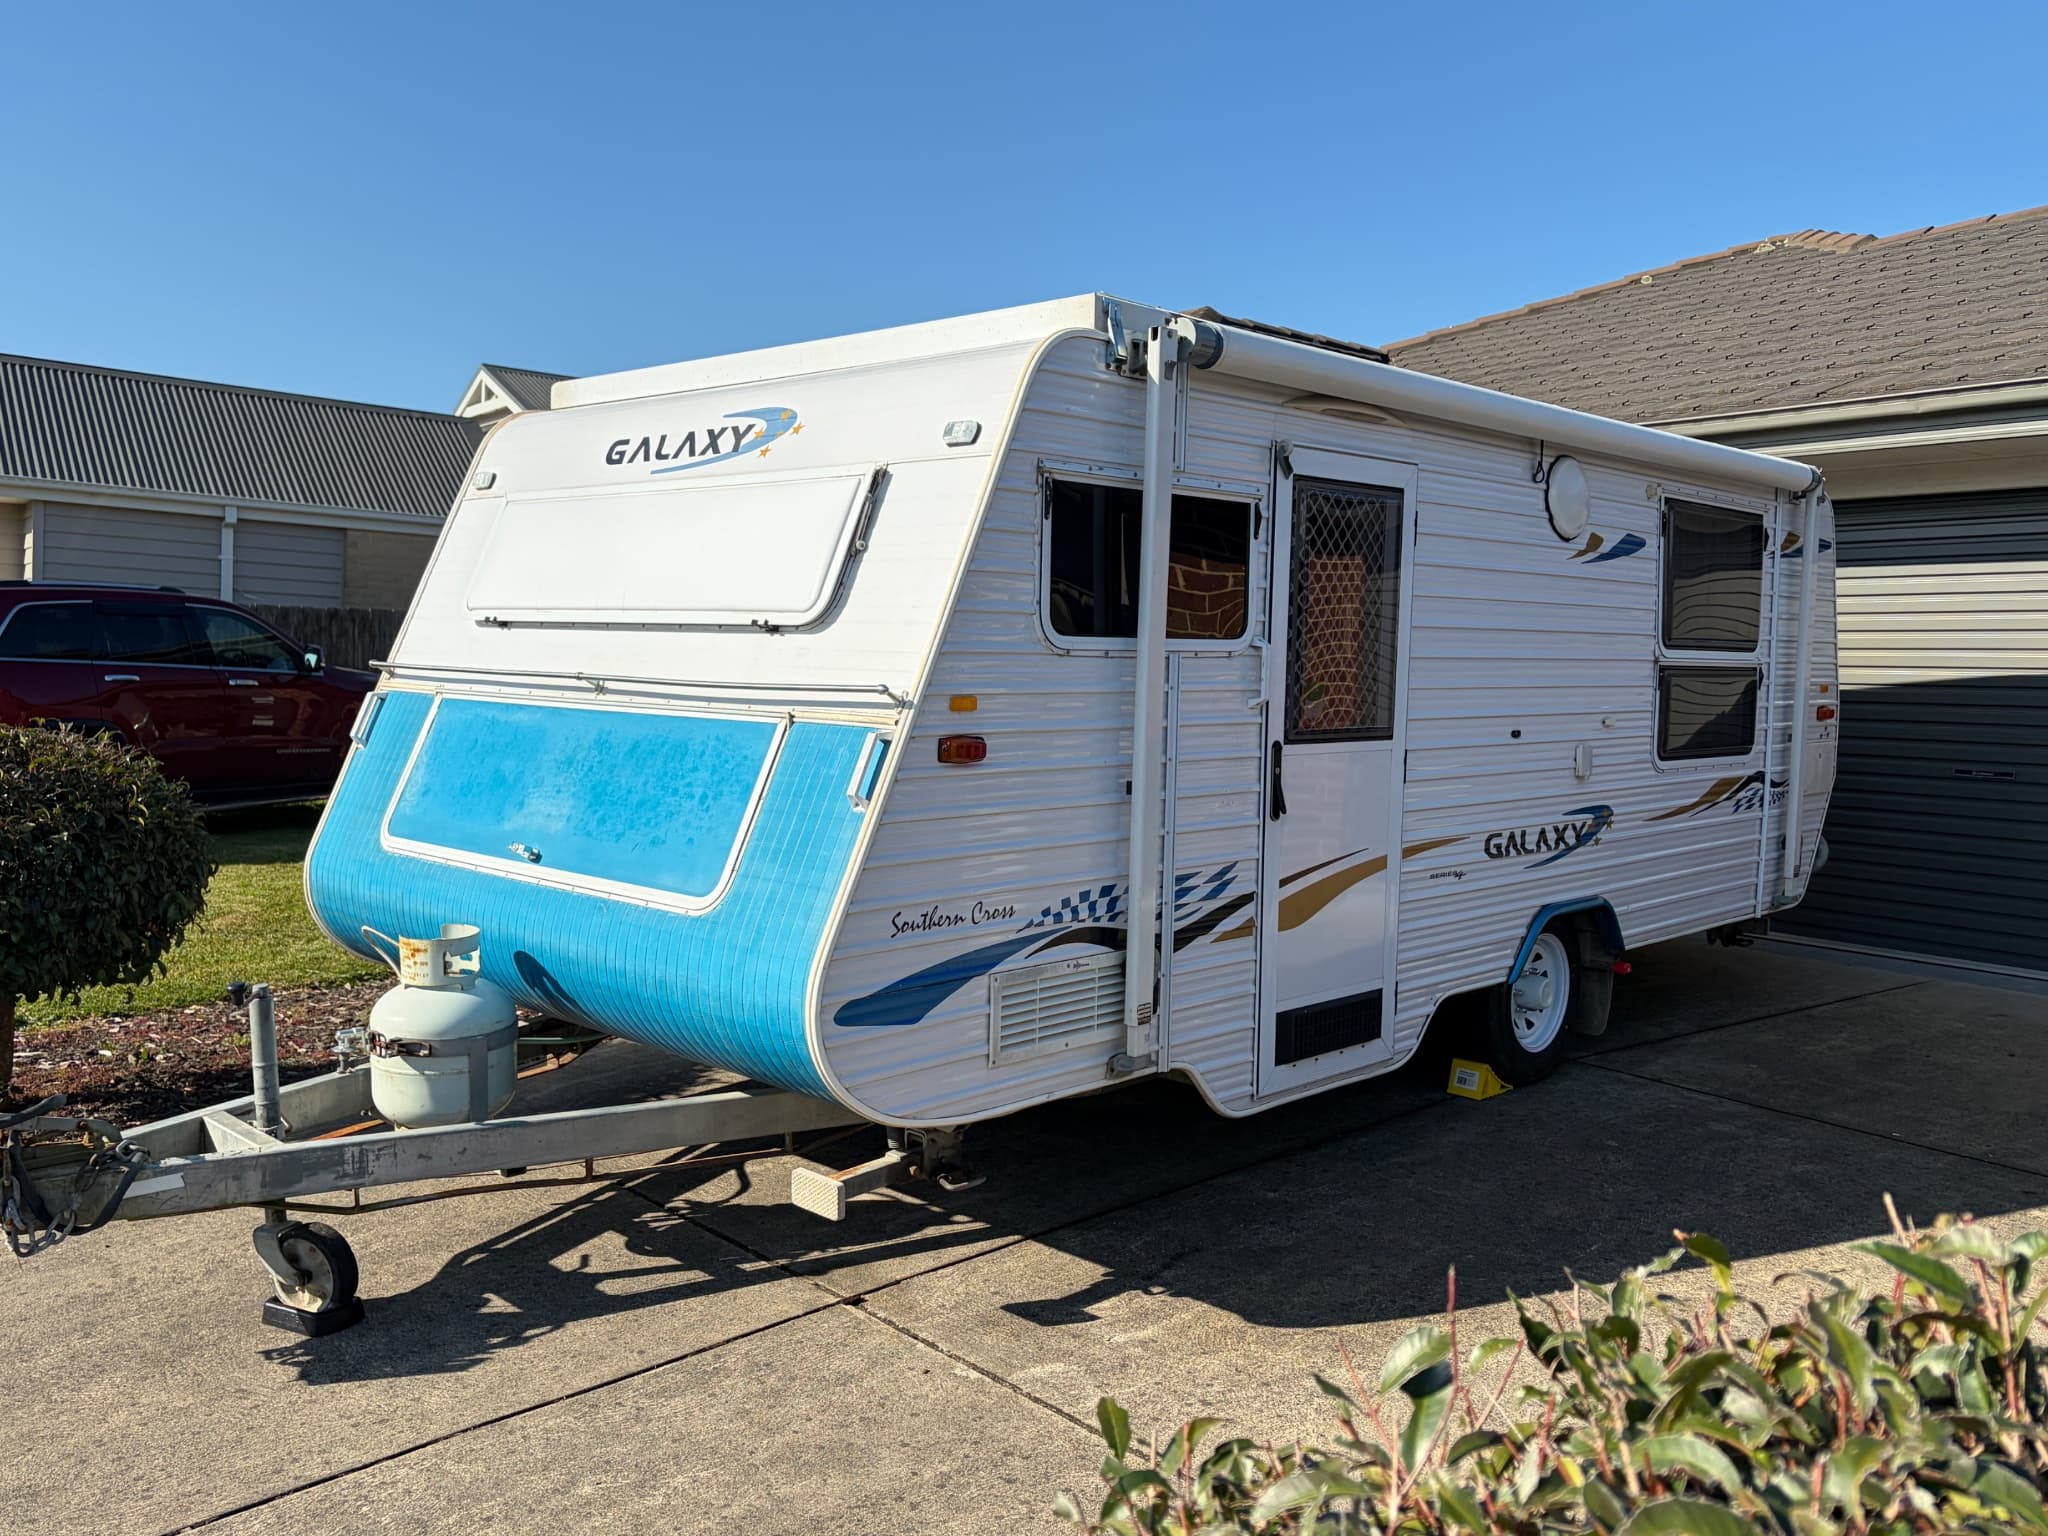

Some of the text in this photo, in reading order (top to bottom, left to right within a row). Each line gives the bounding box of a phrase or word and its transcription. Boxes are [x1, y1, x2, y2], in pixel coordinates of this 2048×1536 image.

[605, 423, 756, 465] GALAXY
[1483, 821, 1588, 859] GALAXY
[890, 901, 1016, 938] Southern Cross
